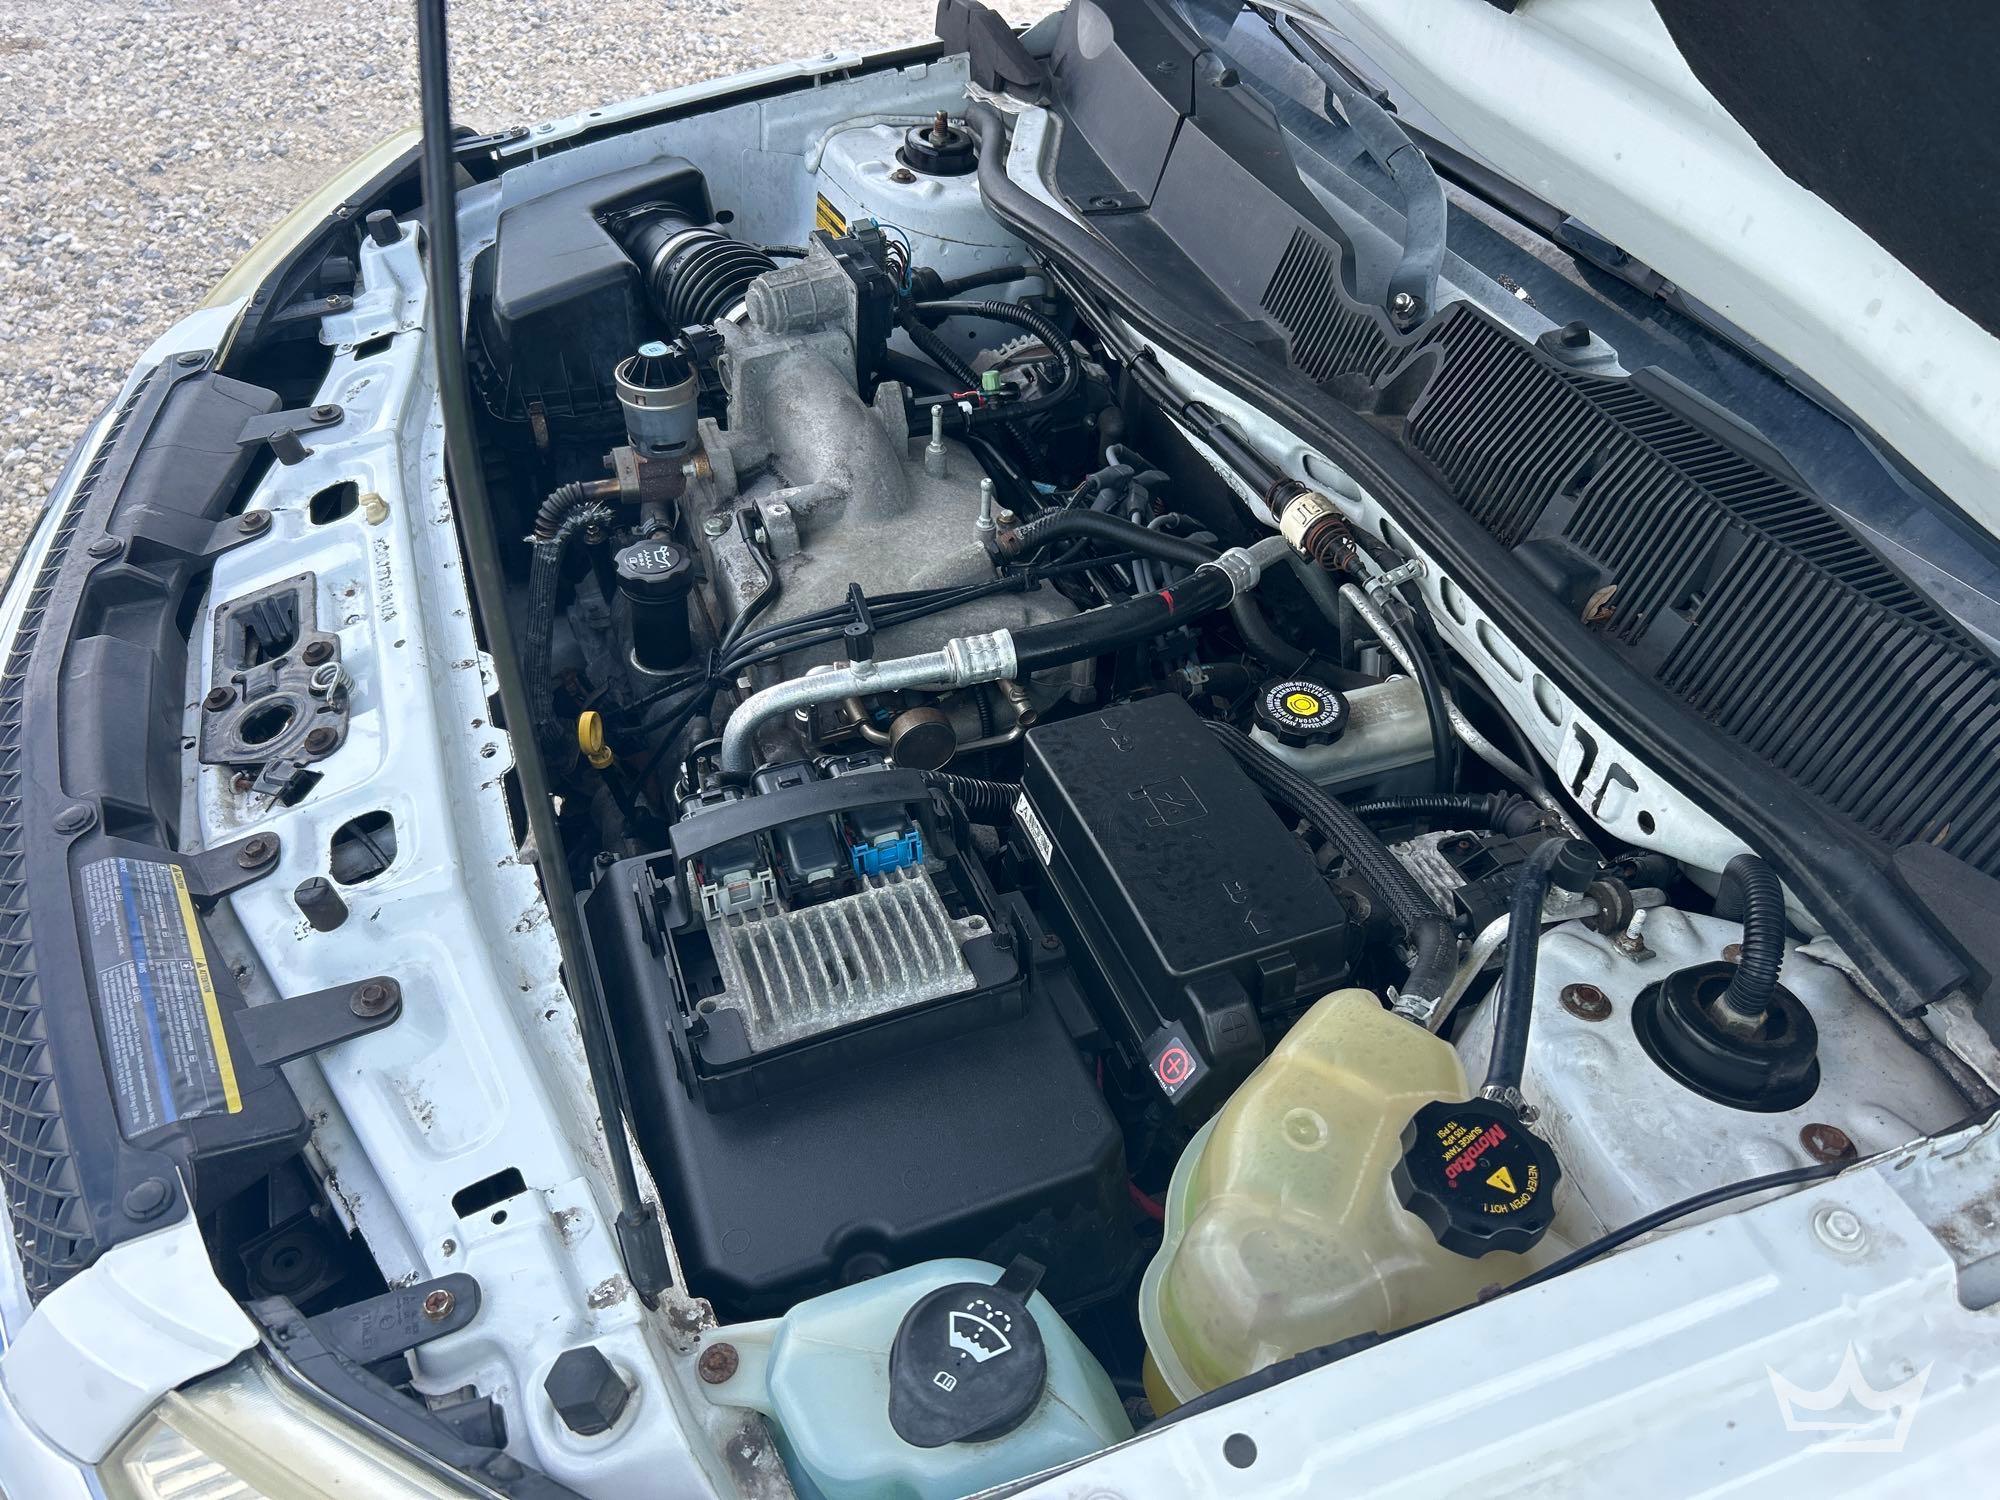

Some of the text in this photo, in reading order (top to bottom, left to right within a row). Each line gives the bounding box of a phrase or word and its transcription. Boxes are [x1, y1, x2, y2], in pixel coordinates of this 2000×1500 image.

[137, 961, 145, 973] AVIS
[198, 968, 211, 992] ATTENTION
[1437, 1121, 1458, 1139] 15 PSI
[1442, 1127, 1466, 1146] 105 kPa
[1442, 1126, 1482, 1160] SURGE TANK
[1527, 1165, 1537, 1192] NEVER
[1490, 1204, 1508, 1213] HOT
[1510, 1193, 1531, 1210] OPEN
